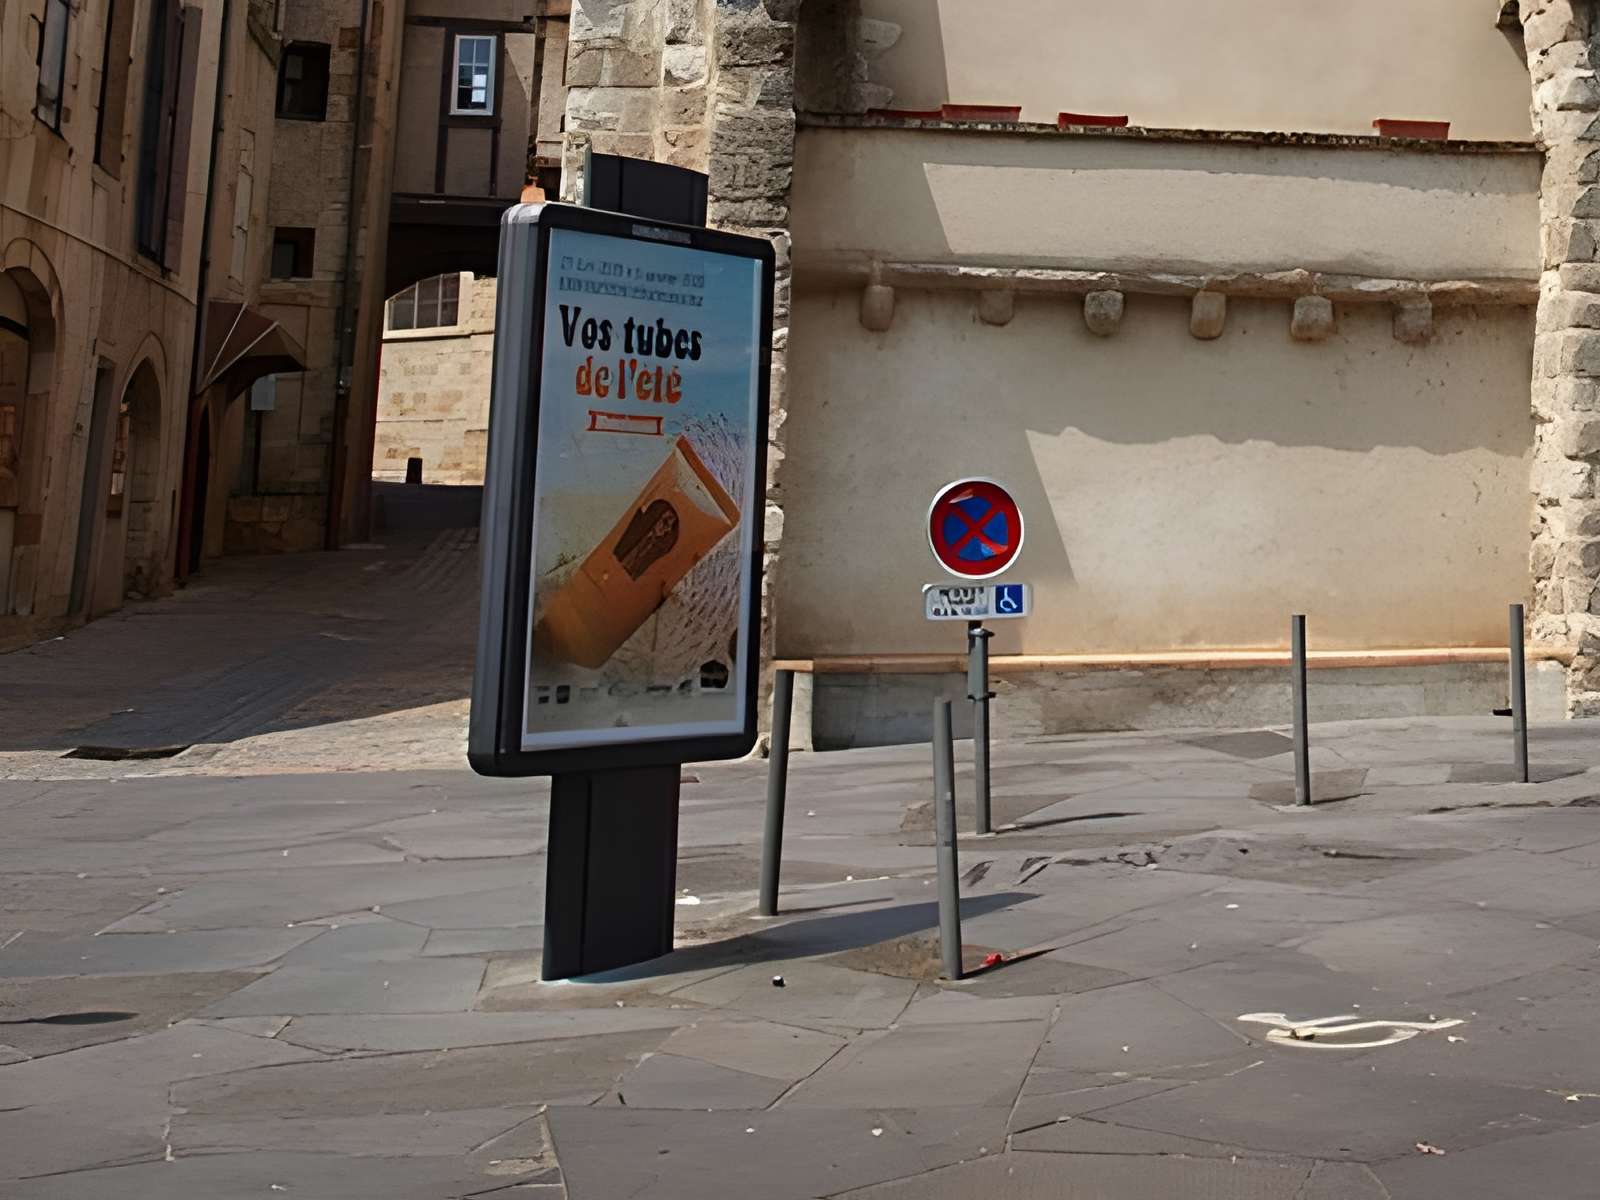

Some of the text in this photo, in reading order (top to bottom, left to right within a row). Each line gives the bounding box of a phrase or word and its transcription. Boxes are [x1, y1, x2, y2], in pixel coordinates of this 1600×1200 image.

[559, 304, 703, 361] Vos tubes
[575, 355, 610, 398] de
